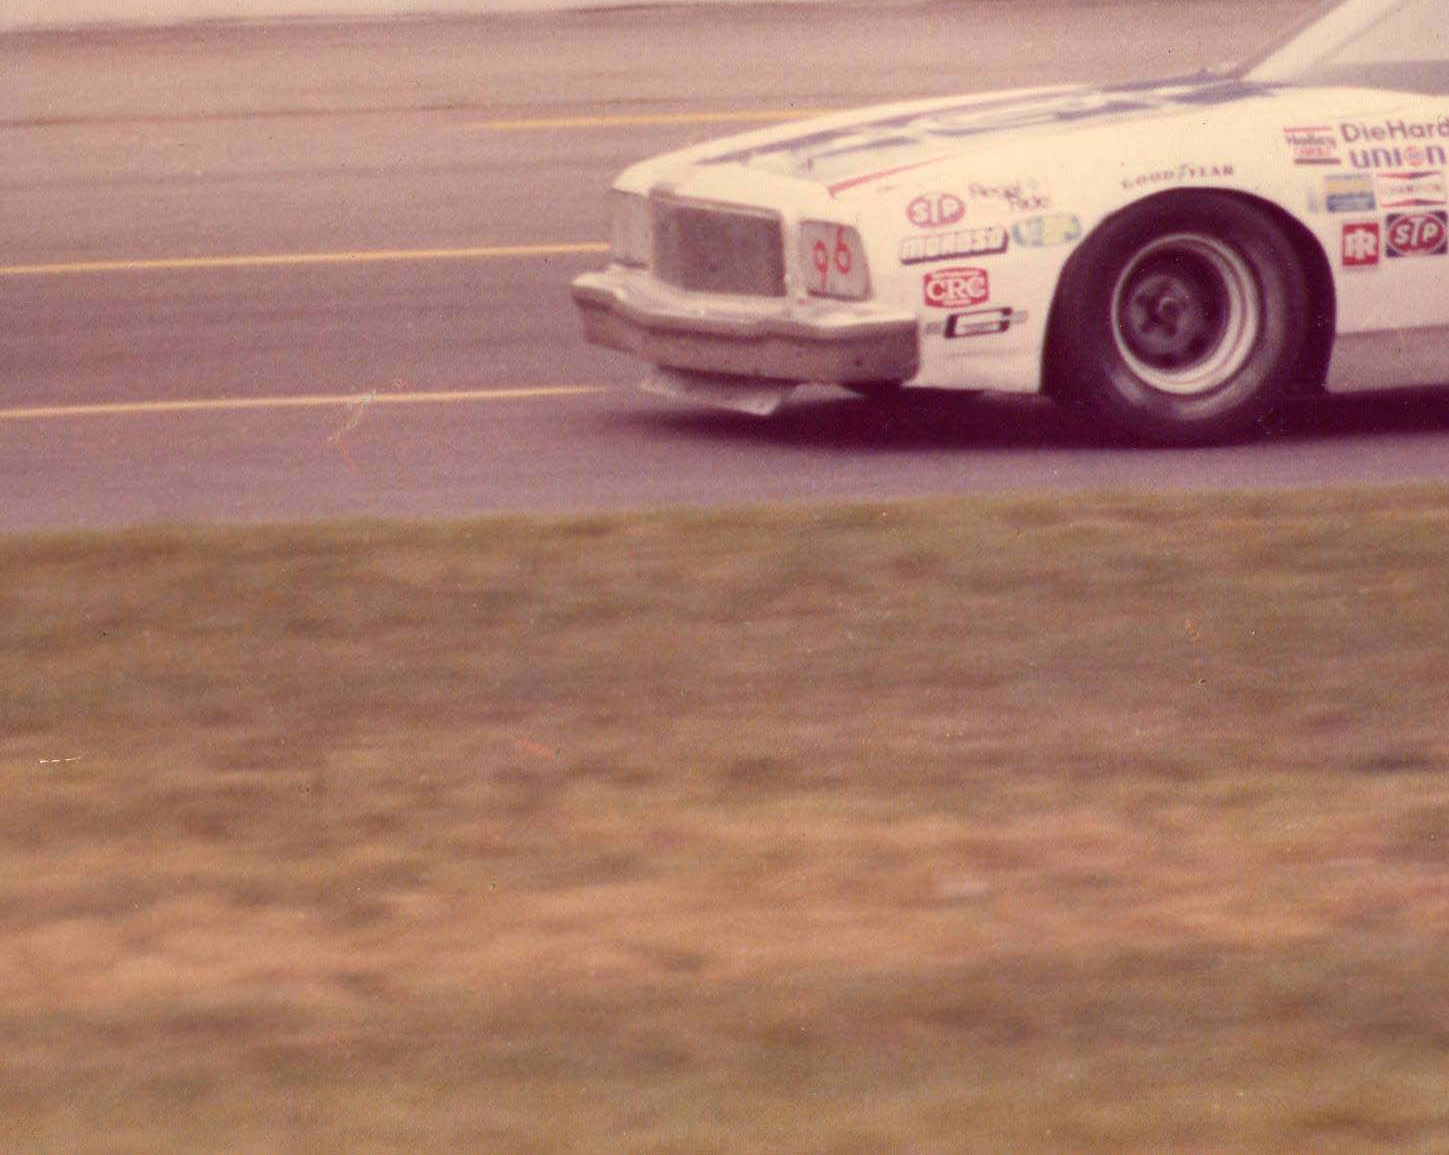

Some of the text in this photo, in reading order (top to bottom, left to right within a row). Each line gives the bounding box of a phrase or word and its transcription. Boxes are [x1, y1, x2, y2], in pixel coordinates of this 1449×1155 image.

[913, 193, 959, 223] STP
[1393, 216, 1439, 251] STP
[812, 225, 853, 294] 96
[926, 276, 987, 300] CRC
